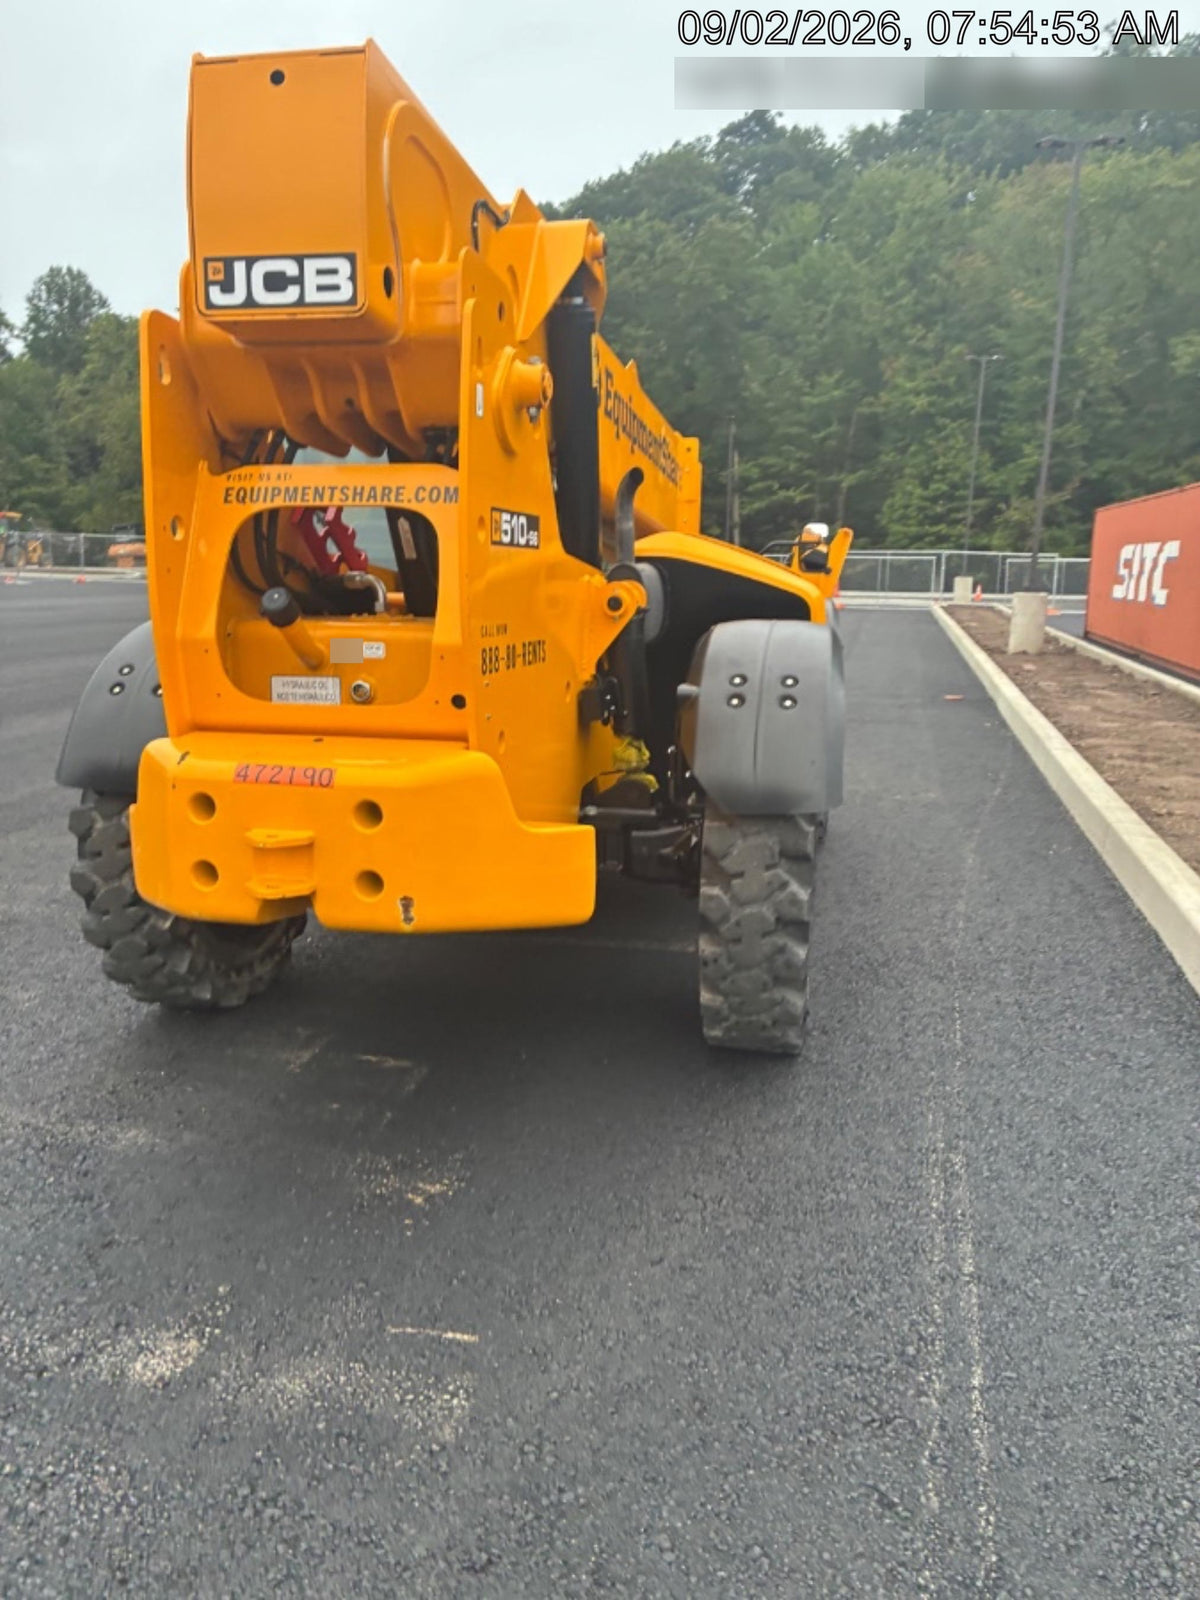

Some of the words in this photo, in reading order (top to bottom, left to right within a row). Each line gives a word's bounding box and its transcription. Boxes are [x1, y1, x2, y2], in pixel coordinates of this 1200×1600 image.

[208, 257, 353, 306] JCB
[226, 472, 254, 482] VISIT
[259, 472, 272, 481] US
[223, 485, 460, 504] EQUIPMENTSHARE.COM
[1112, 540, 1181, 606] SITC
[236, 763, 334, 788] 472190
